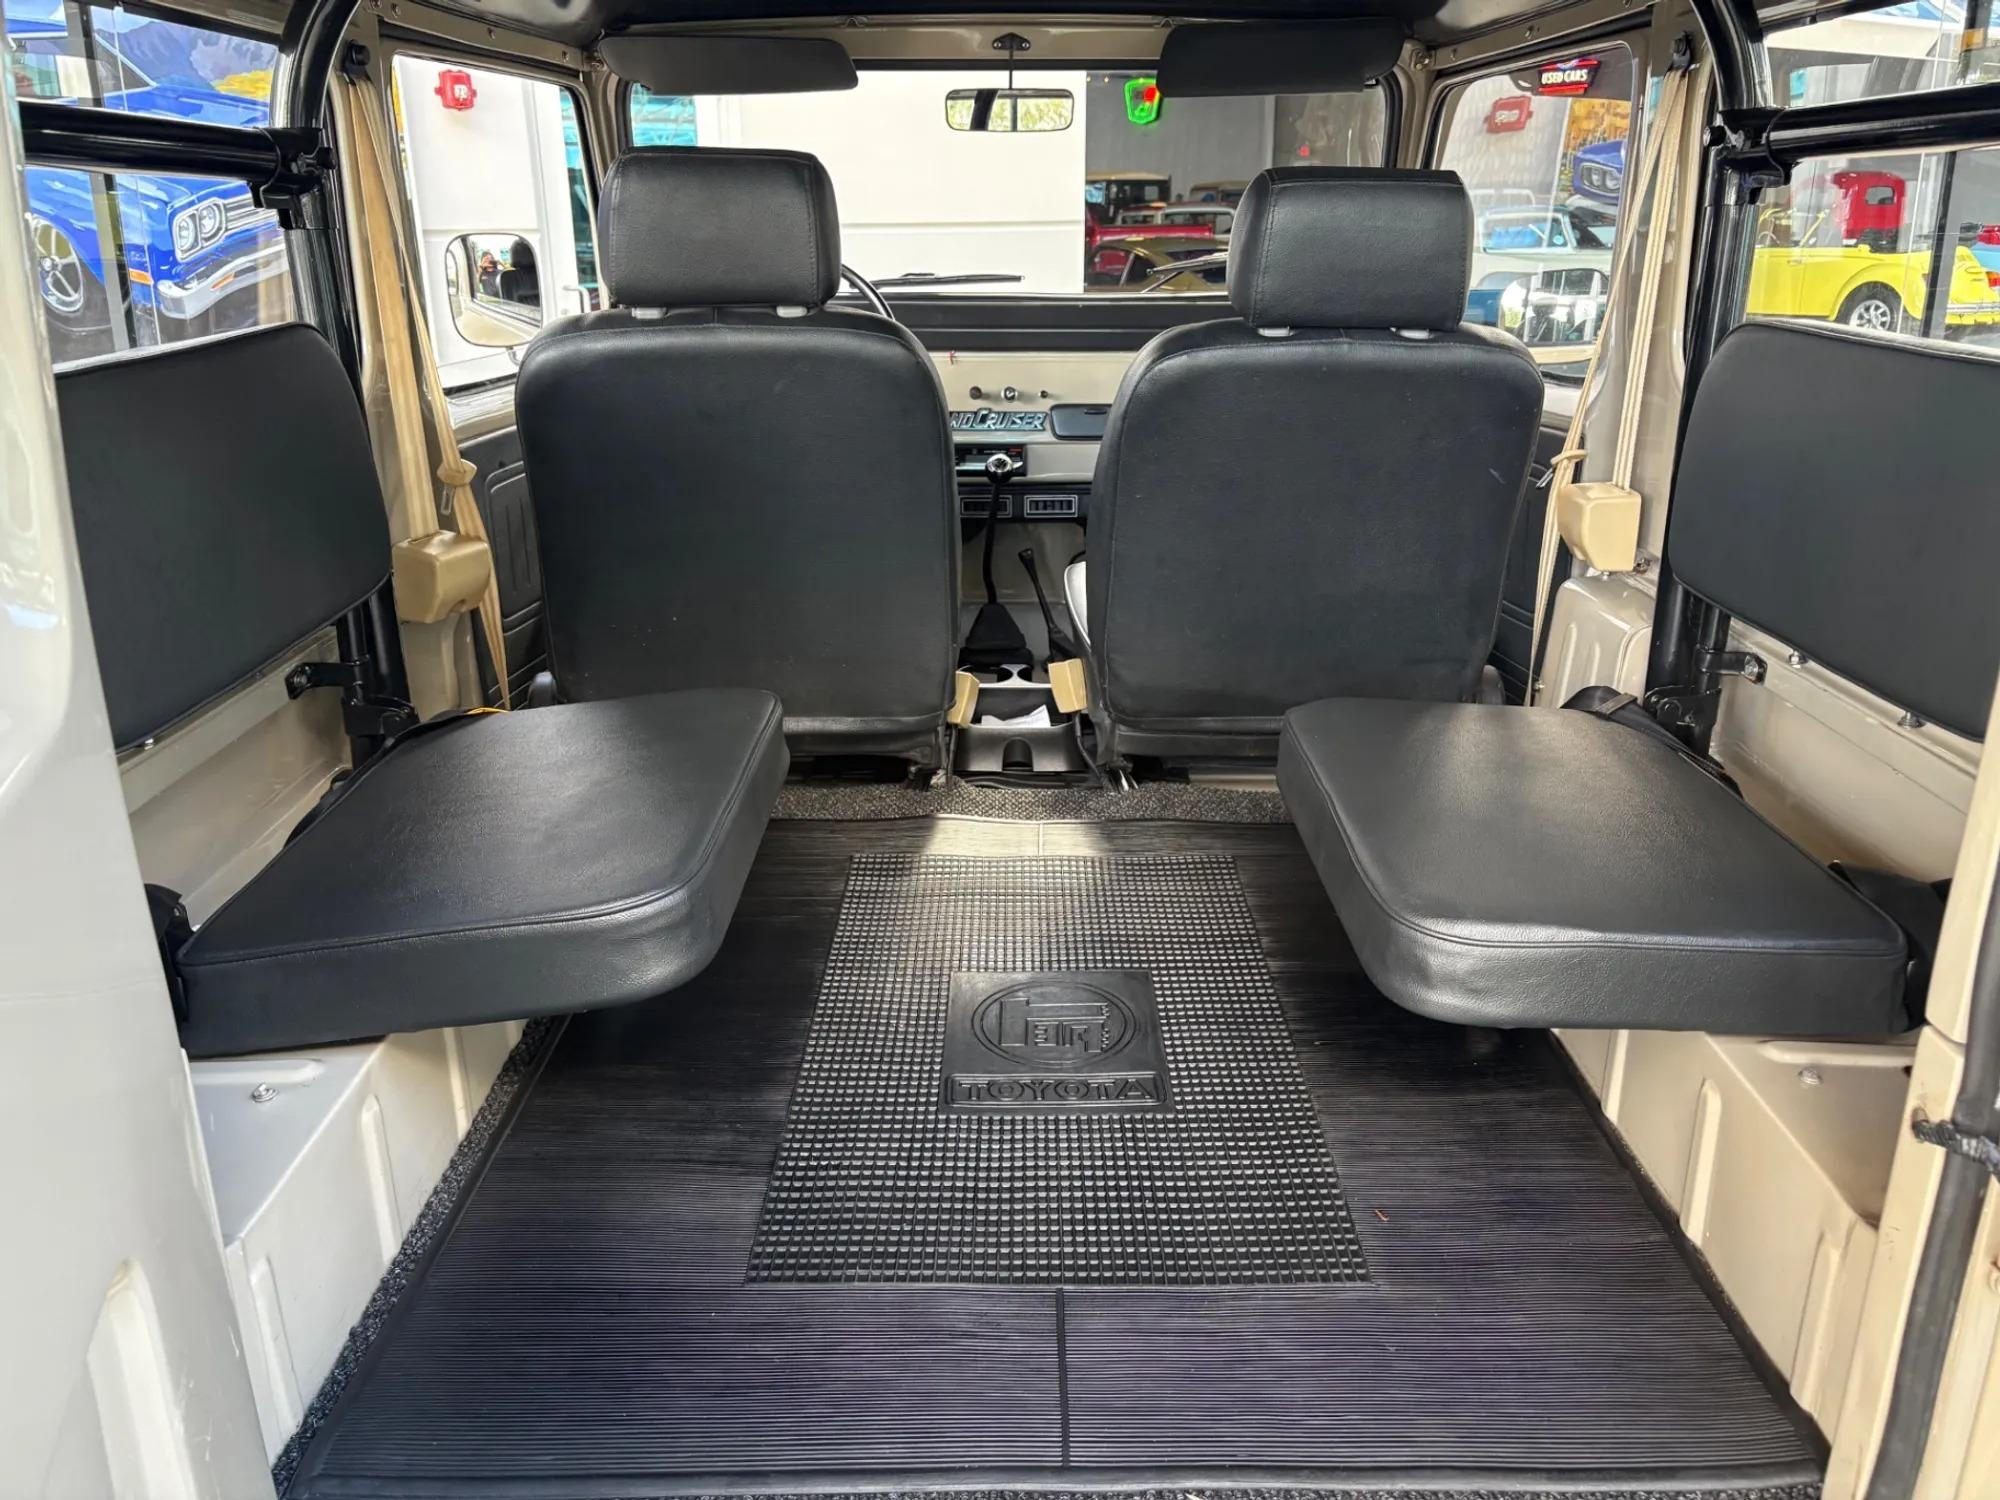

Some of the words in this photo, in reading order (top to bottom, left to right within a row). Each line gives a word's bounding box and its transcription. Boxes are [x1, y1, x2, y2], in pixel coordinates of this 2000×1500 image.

[1541, 71, 1563, 84] USED
[1564, 69, 1588, 83] CARS
[973, 409, 1045, 429] CRUISER
[959, 1078, 1153, 1101] TOYOTA
